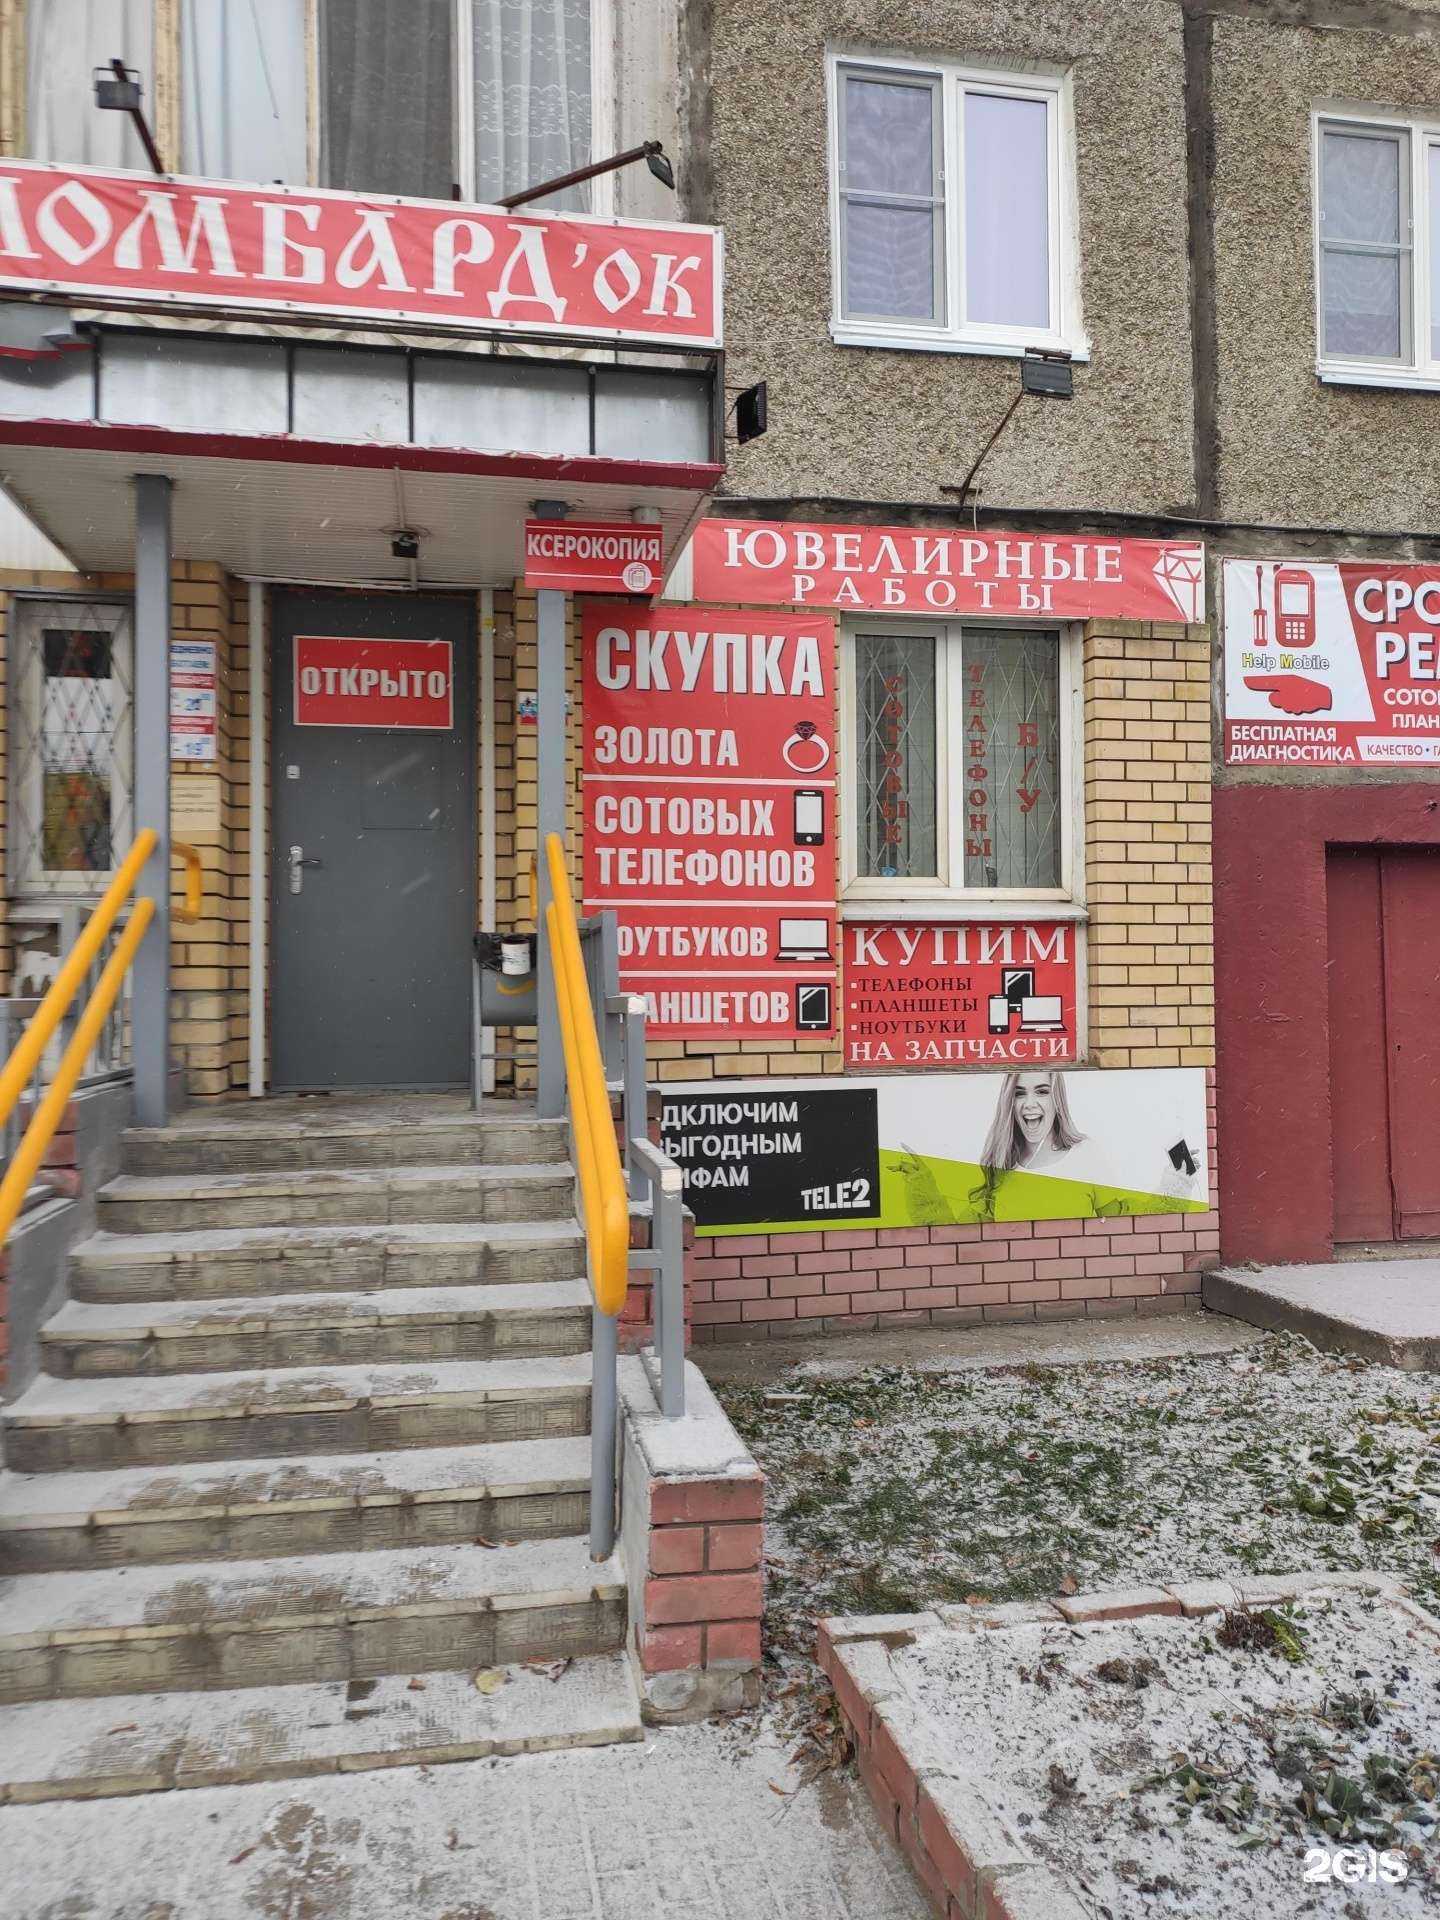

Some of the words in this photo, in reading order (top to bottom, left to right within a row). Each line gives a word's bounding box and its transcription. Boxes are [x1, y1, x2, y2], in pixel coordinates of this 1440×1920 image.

[527, 534, 660, 561] КСЕРОКОПИЯ
[723, 528, 1123, 583] ЮВЕЛИРНЫЕ
[791, 574, 1054, 610] РАБОТЫ
[595, 628, 825, 697] СКУПКА
[1242, 653, 1276, 671] Help
[1279, 654, 1330, 670] Mobile
[1375, 631, 1440, 679] РЕ
[301, 666, 447, 699] ОТКРЫТО
[1383, 687, 1440, 706] СОТО
[594, 725, 740, 767] ЗОЛОТА
[1231, 726, 1337, 742] БЕСПЛАТНАЯ
[966, 664, 992, 857] ТЕЛЕФОНЫ
[1229, 744, 1355, 762] ДИАГНОСТИКА
[1367, 744, 1423, 756] КАЧЕСТВО
[594, 795, 775, 836] СОТОВЫХ
[595, 847, 815, 887] ТЕЛЕФОНОВ
[617, 926, 768, 957] ОУТБУКОВ
[852, 926, 1069, 966] КУПИМ
[858, 976, 972, 993] ТЕЛЕФОНЫ
[619, 990, 790, 1024] АНШЕТОВ
[859, 997, 978, 1014] ПЛАНШЕТЫ
[860, 1019, 967, 1035] НОУТБУКИ
[850, 1041, 896, 1062] НА
[904, 1037, 1070, 1061] ЗАПЧАСТИ
[661, 1101, 799, 1131] ДКЛЮЧИМ
[800, 1178, 871, 1210] TELE2
